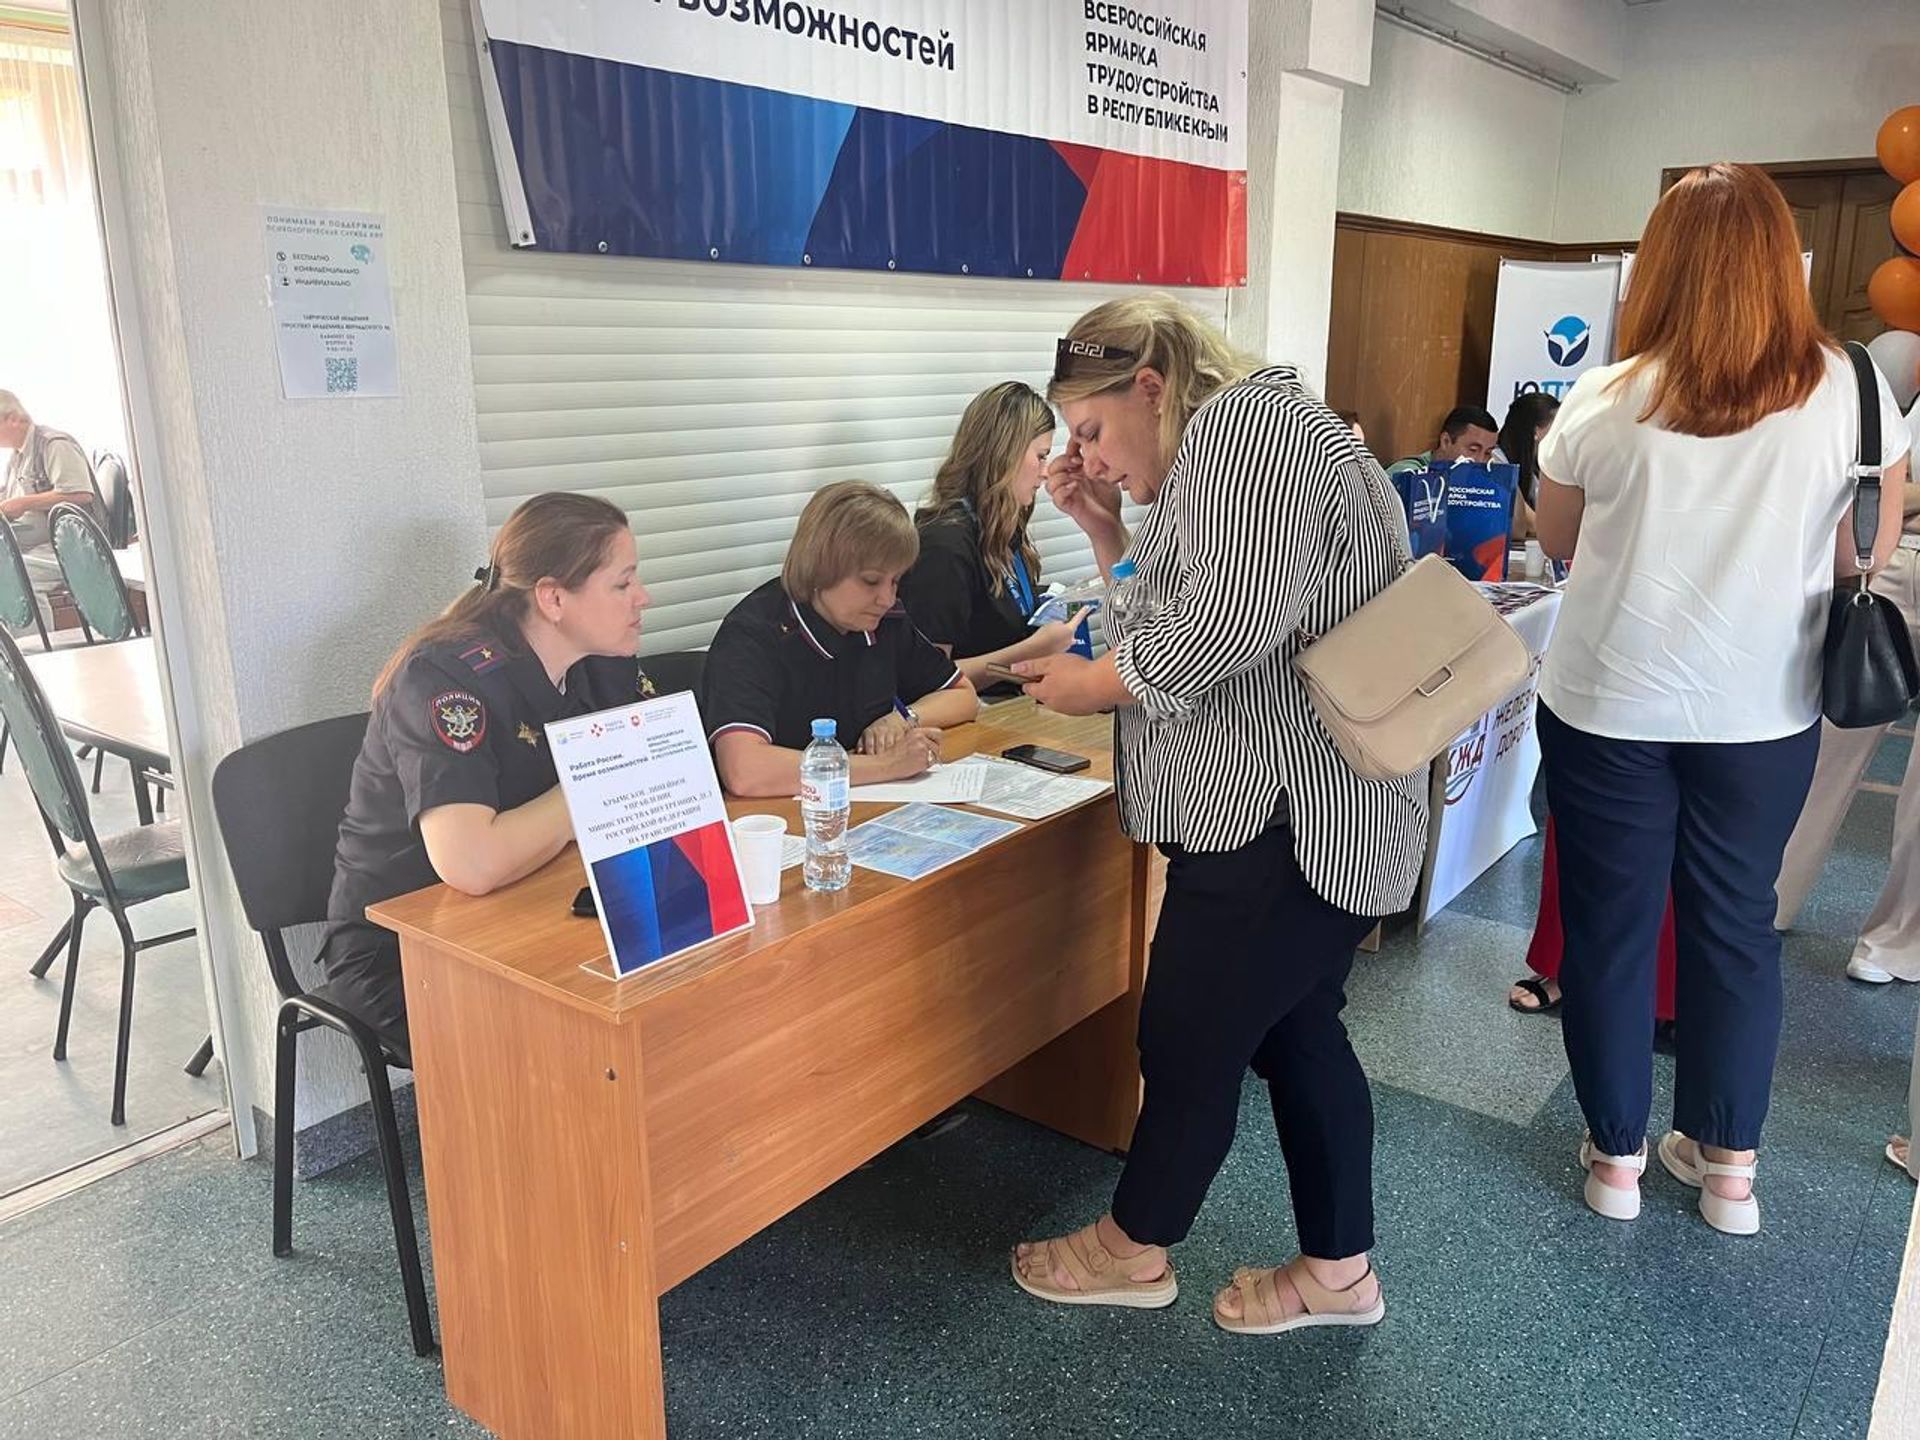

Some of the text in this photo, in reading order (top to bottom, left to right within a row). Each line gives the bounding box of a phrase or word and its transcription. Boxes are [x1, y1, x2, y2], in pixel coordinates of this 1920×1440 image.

[1085, 0, 1206, 52] ВСЕРОССИЙСКАЯ
[1086, 32, 1158, 67] ЯРМАРКА
[1087, 63, 1219, 113] ТРУДОУСТРОЙСТВА
[1088, 95, 1098, 114] В
[569, 758, 596, 772] Работа
[571, 770, 598, 783] Время
